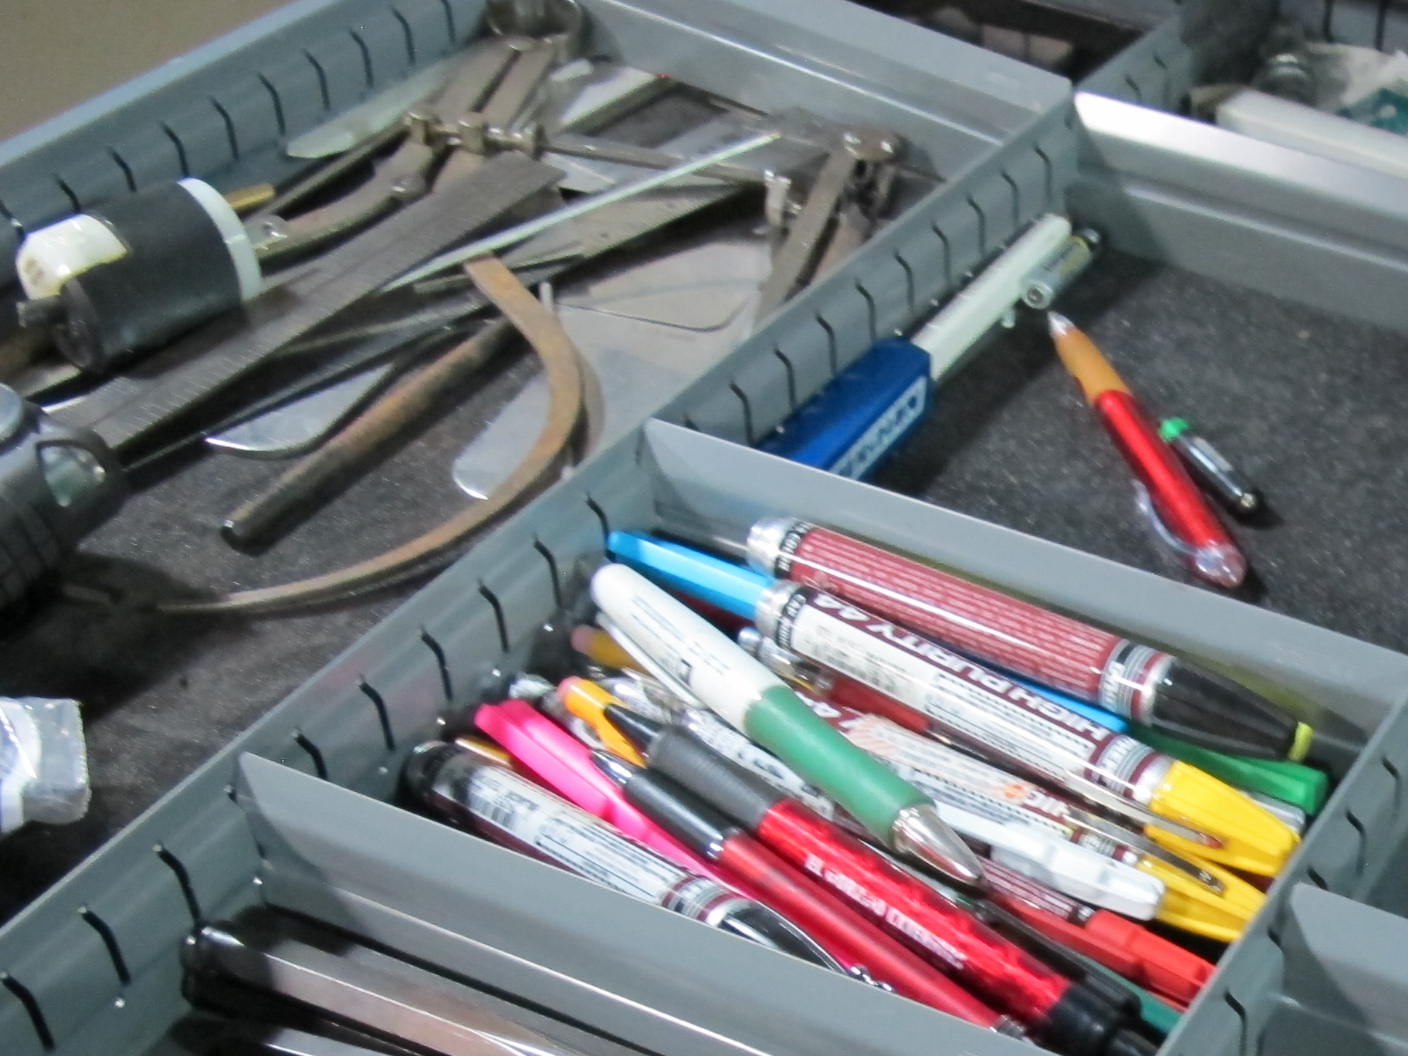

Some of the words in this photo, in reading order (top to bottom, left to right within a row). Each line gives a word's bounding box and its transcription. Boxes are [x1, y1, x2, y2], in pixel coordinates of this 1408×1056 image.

[813, 593, 871, 622] 44
[865, 622, 1013, 695] PURITY
[1006, 685, 1111, 742] HIGH
